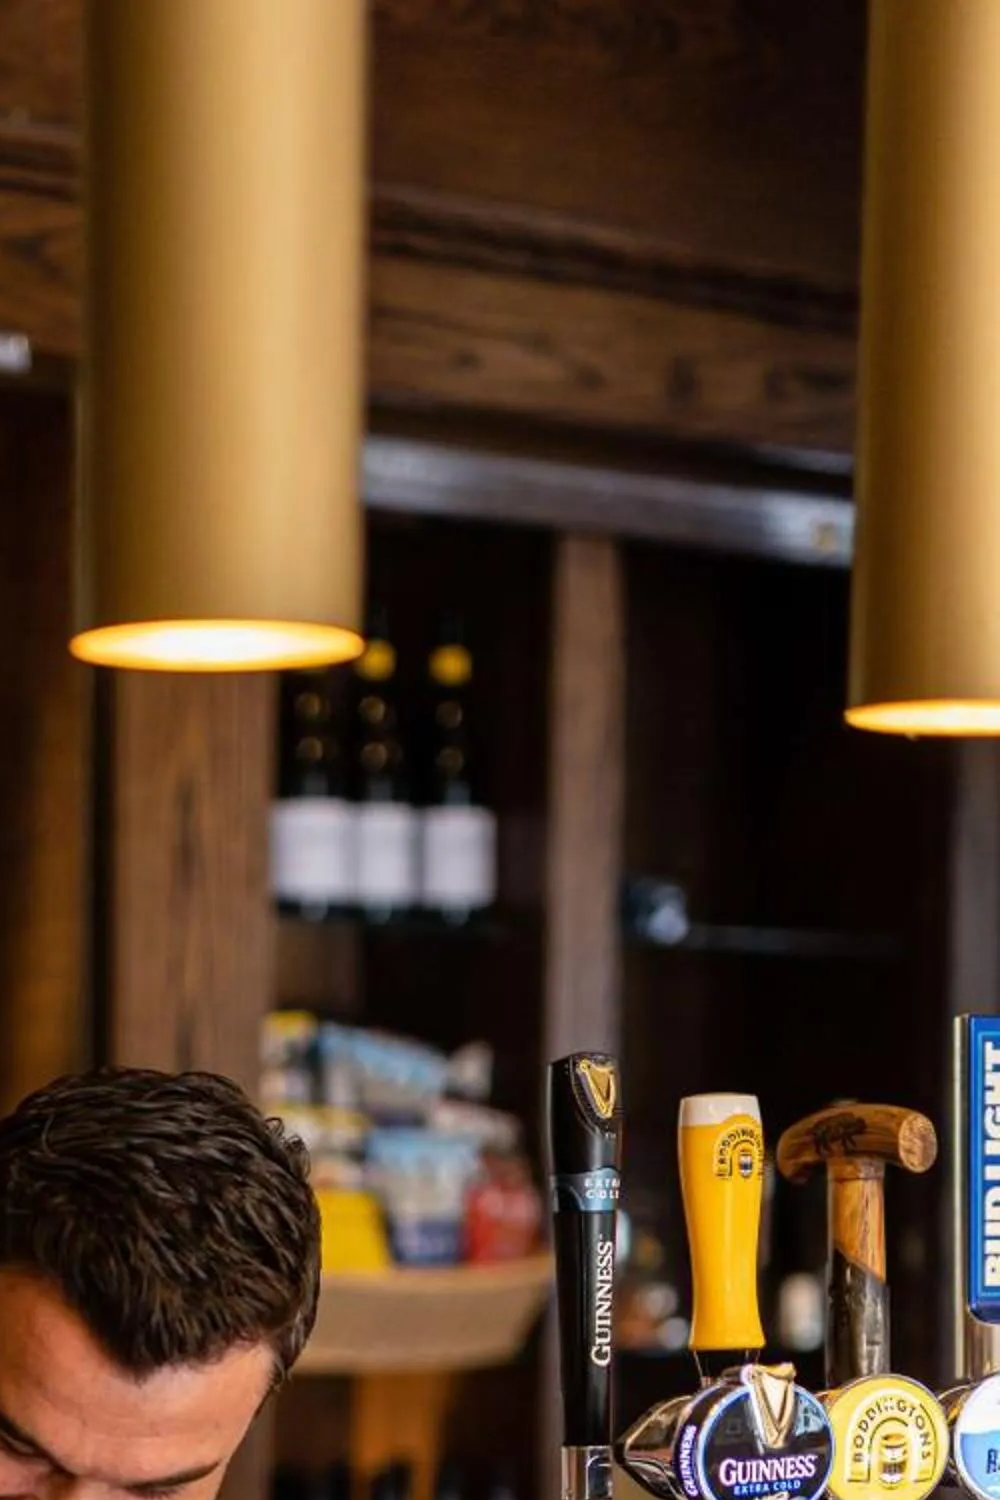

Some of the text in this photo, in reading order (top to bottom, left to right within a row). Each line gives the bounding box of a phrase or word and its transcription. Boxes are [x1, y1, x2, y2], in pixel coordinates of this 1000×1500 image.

[590, 1241, 613, 1366] GUINNESS
[679, 1425, 699, 1497] GUINNESS
[853, 1397, 931, 1462] BODDINGTONS
[719, 1455, 816, 1486] GUINNESS
[733, 1479, 801, 1496] EXTRA COLD
